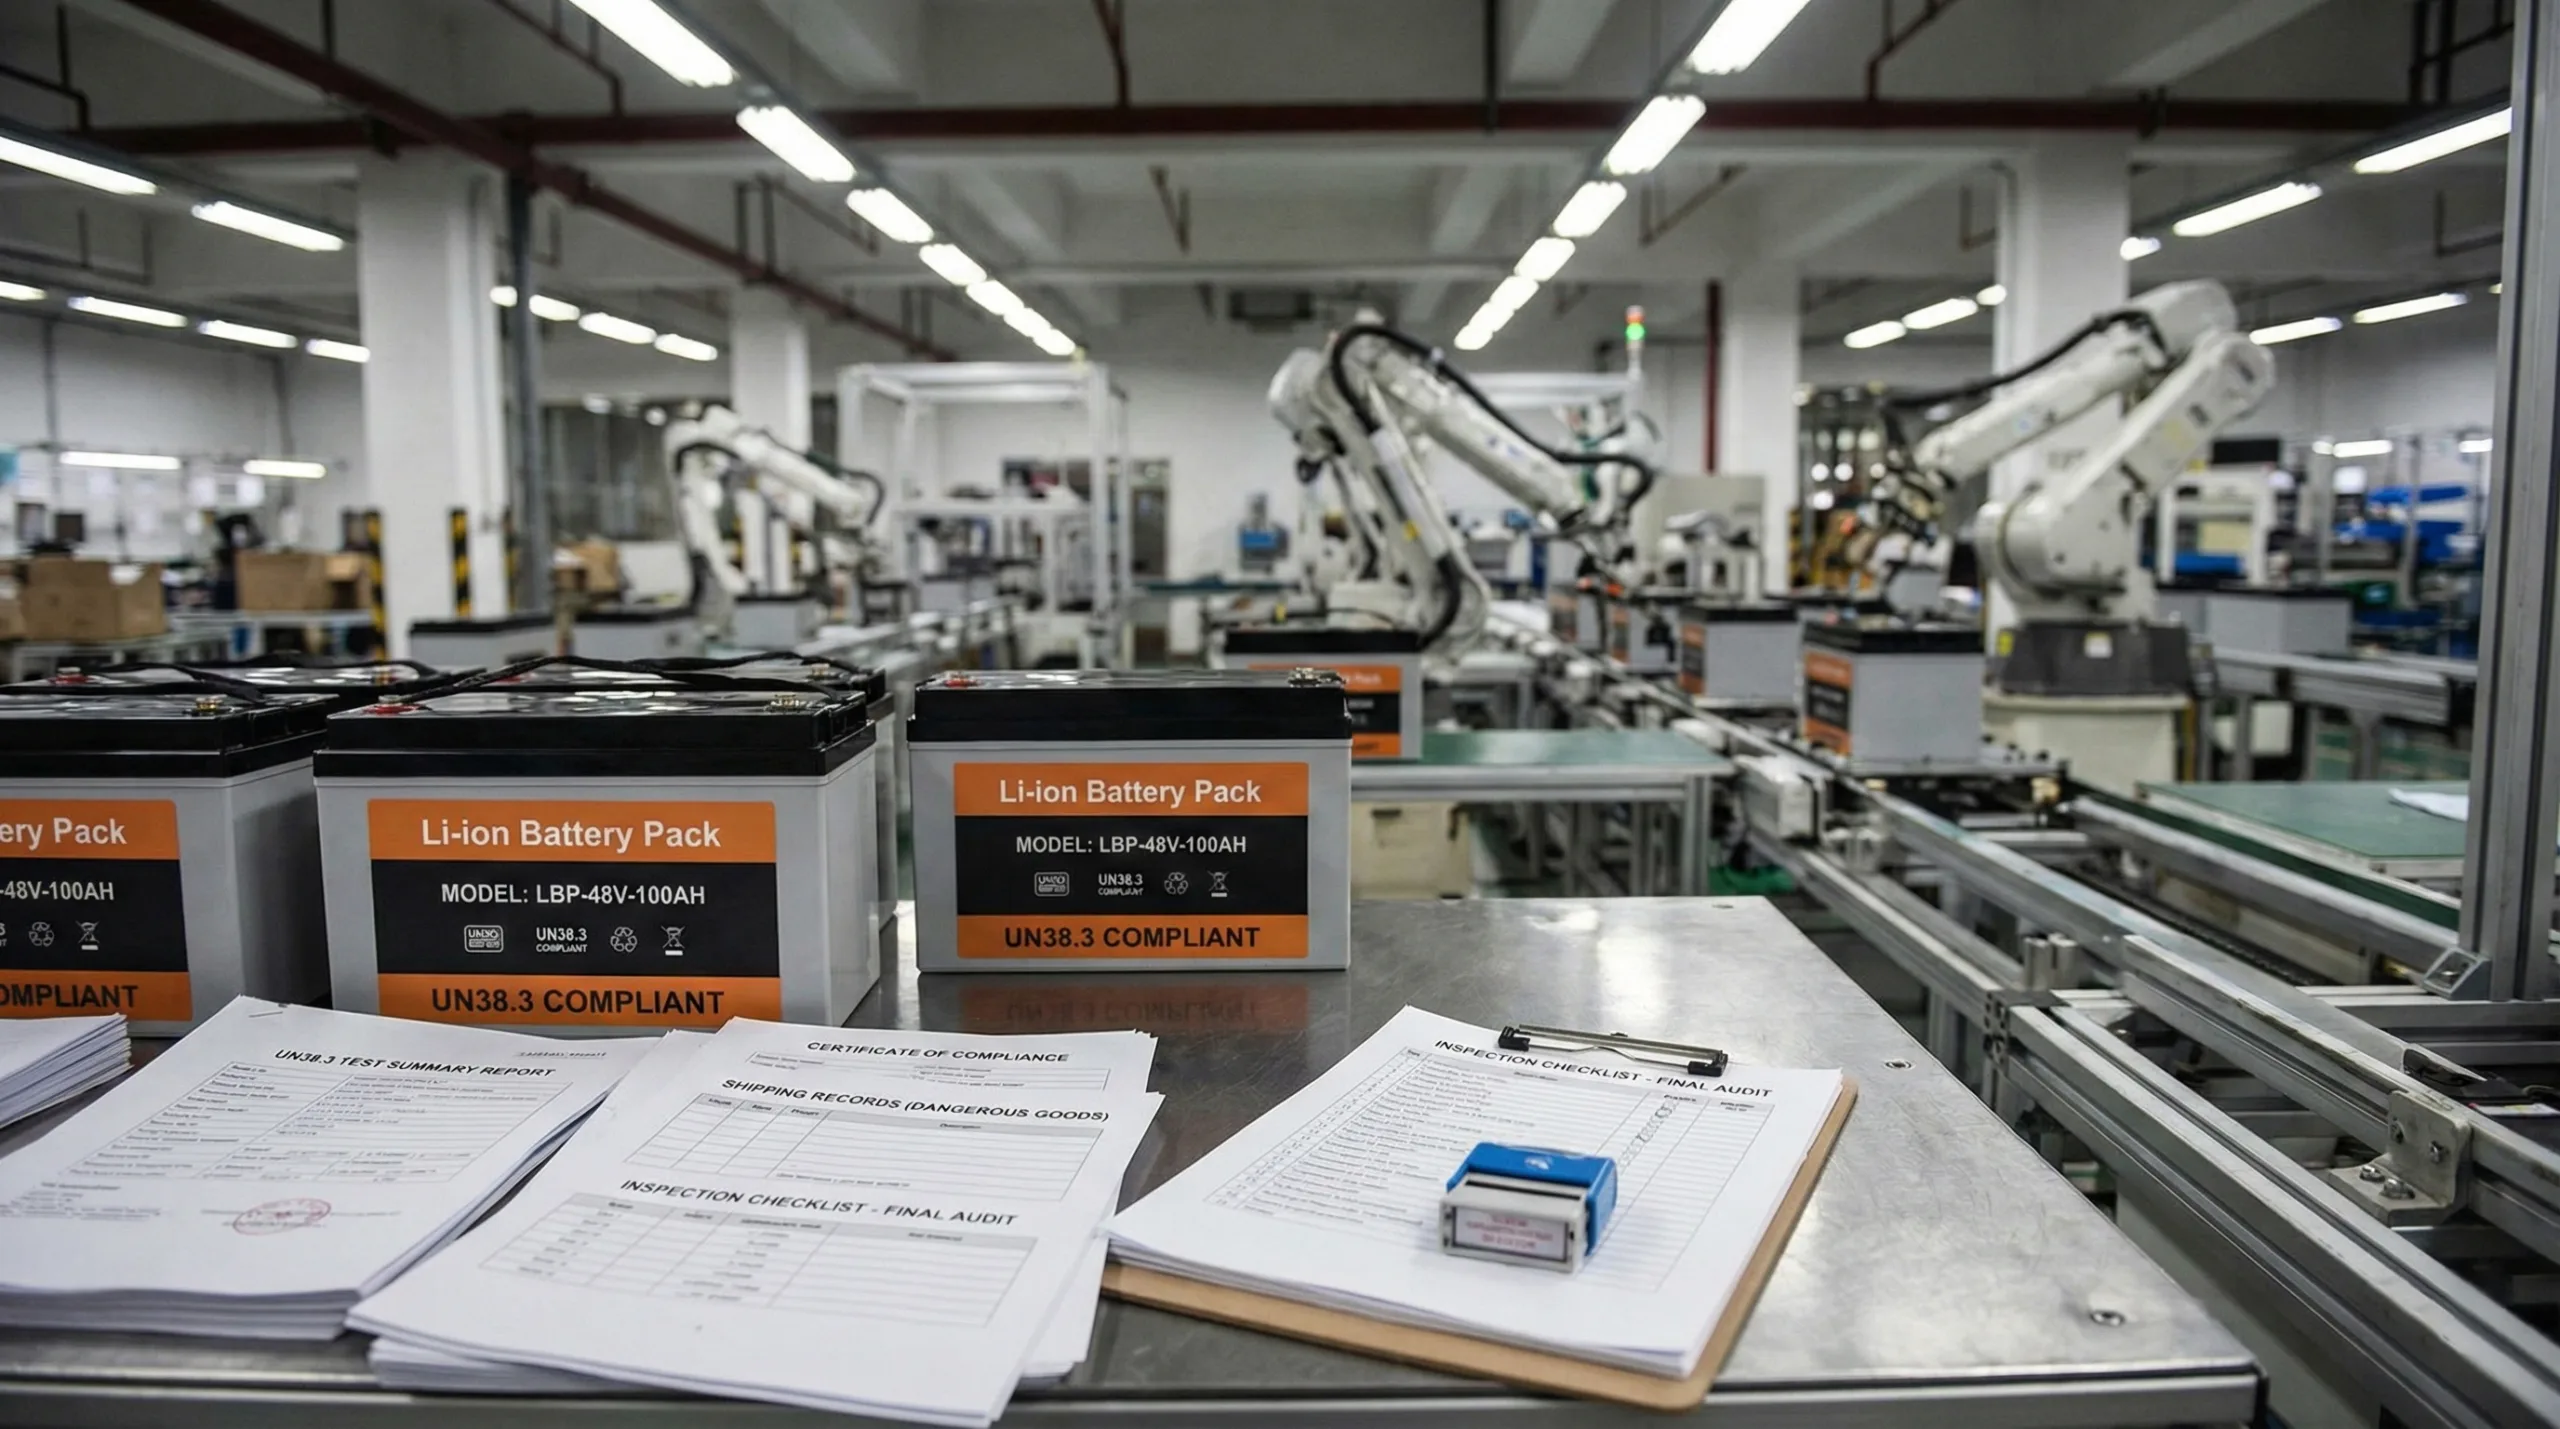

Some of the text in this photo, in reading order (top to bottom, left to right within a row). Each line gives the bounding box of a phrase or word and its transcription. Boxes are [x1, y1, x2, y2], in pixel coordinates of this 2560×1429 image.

[1000, 779, 1262, 808] Li-ion Battery Pack
[0, 817, 128, 851] ery Pack
[421, 819, 721, 854] Li-ion Battery Pack
[1016, 836, 1247, 853] MODEL: LBP-48V-100AH
[441, 883, 706, 905] MODEL: LBP-48V-100AH
[536, 927, 587, 942] UN38.3
[1004, 927, 1261, 948] UN38.3 COMPLIANT
[432, 988, 725, 1014] UN38.3 COMPLIANT
[807, 1042, 1070, 1063] CERTIFICATE OF COMPLIANCE
[339, 1056, 385, 1069] TEST
[386, 1060, 480, 1075] SUMMARY
[479, 1066, 556, 1078] REPORT
[1434, 1040, 1536, 1066] INSPECTION
[1541, 1061, 1644, 1082] CHECKLIST
[1655, 1076, 1709, 1091] FINAL
[1713, 1084, 1773, 1098] AUDIT
[721, 1079, 1110, 1123] SHIPPING RECORDS (DANGEROUS GOODS)
[620, 1179, 745, 1203] INSPECTION
[748, 1194, 868, 1214] CHECKLIST
[882, 1204, 944, 1221] FINAL
[947, 1210, 1019, 1226] AUDIT
